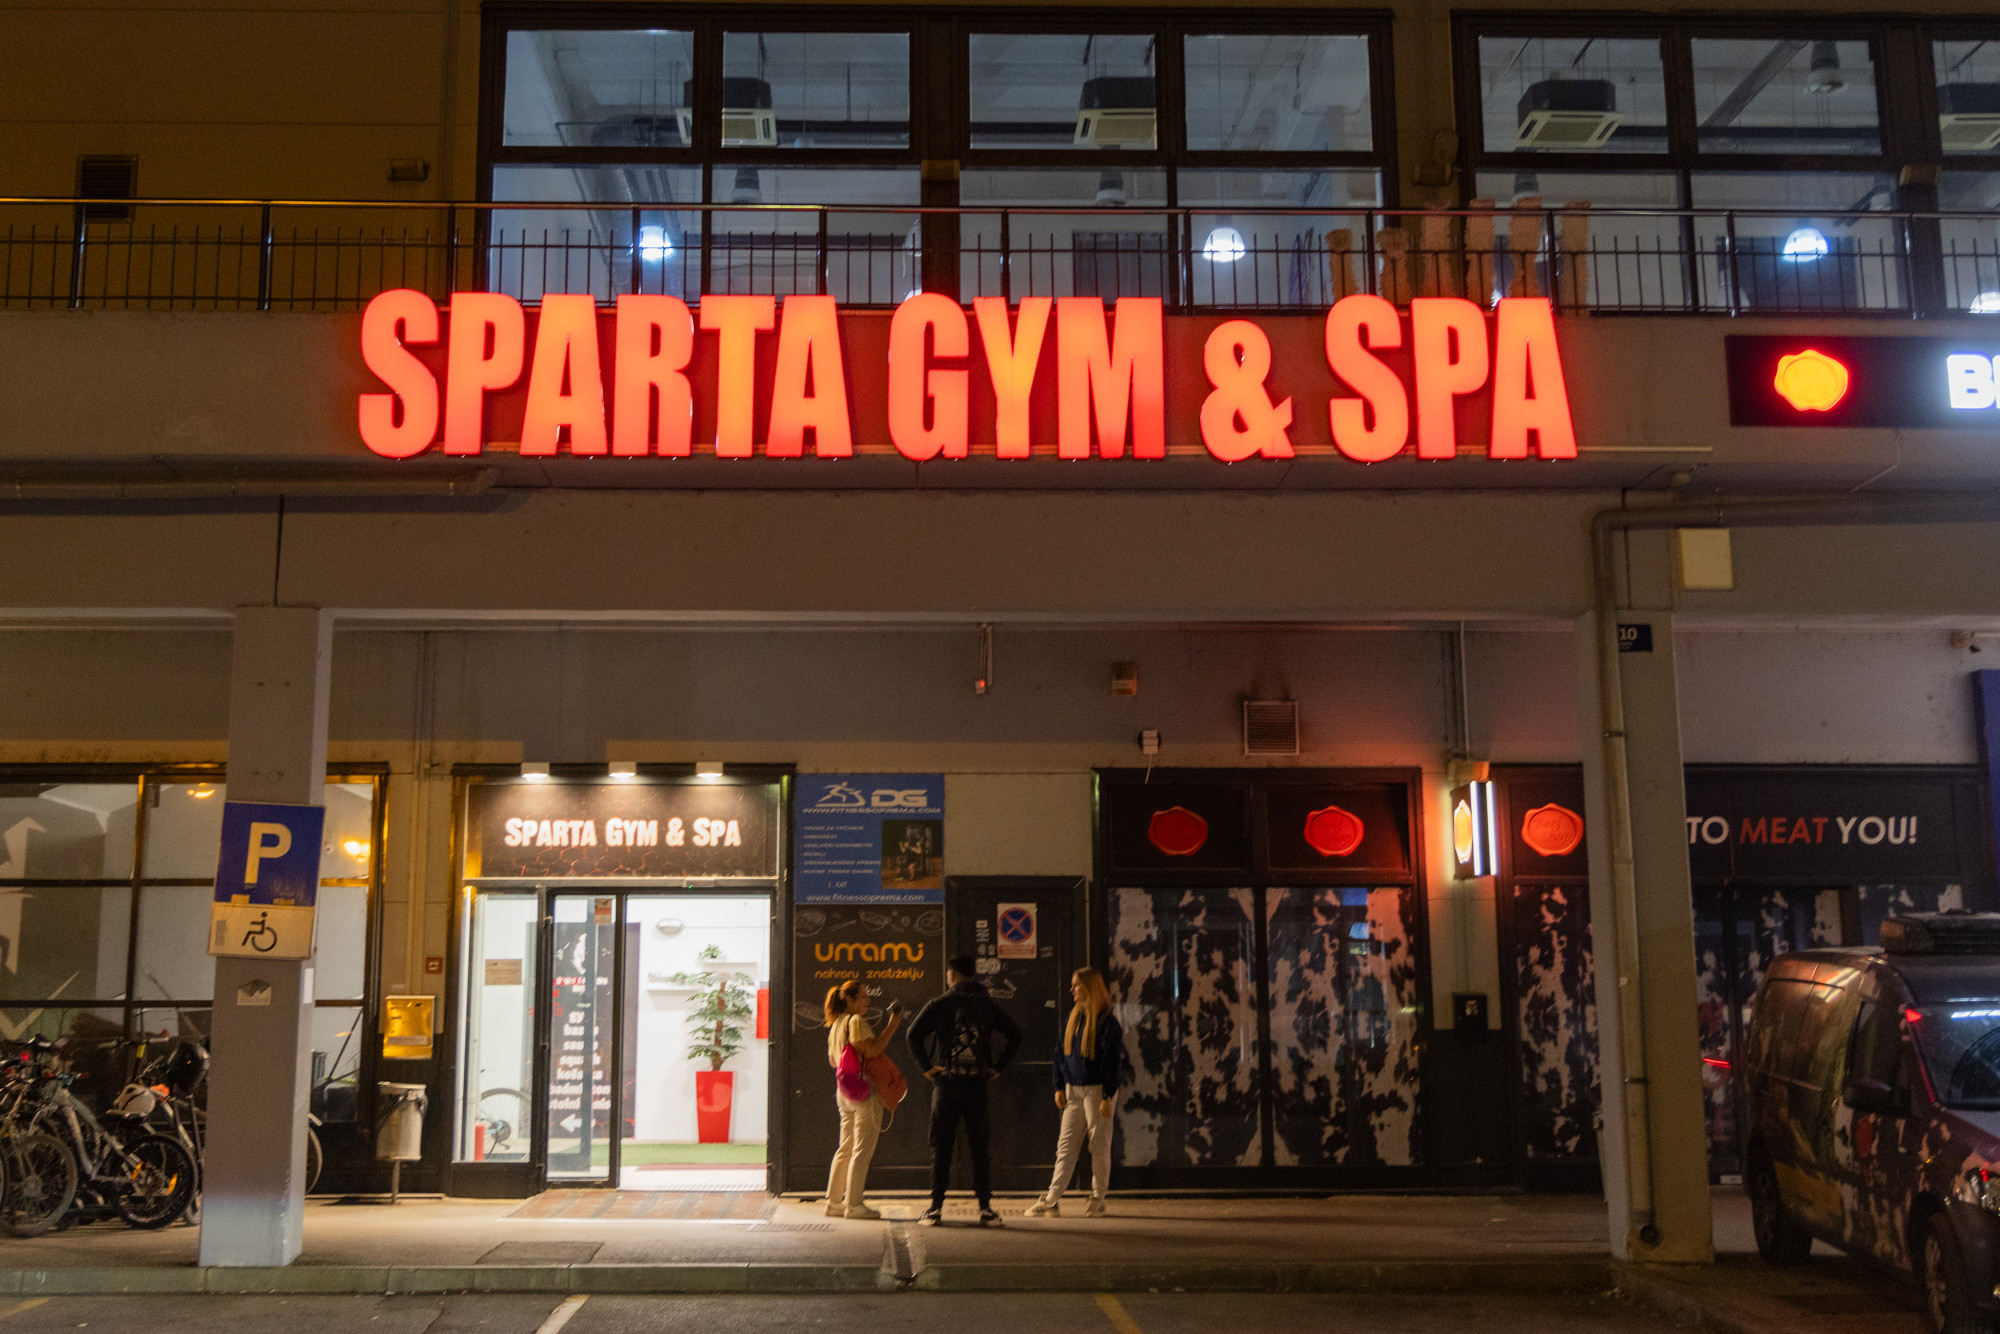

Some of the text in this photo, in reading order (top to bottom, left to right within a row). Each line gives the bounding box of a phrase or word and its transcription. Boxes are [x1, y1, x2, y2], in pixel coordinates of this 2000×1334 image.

[358, 288, 1578, 462] SPARTA GYM & SPA
[1946, 354, 2000, 409] B
[1619, 627, 1638, 641] 10
[504, 817, 742, 847] SPARTA GYM & SPA
[1685, 815, 1918, 845] TO MEAT YOU!
[244, 822, 293, 886] P
[815, 942, 925, 963] umami
